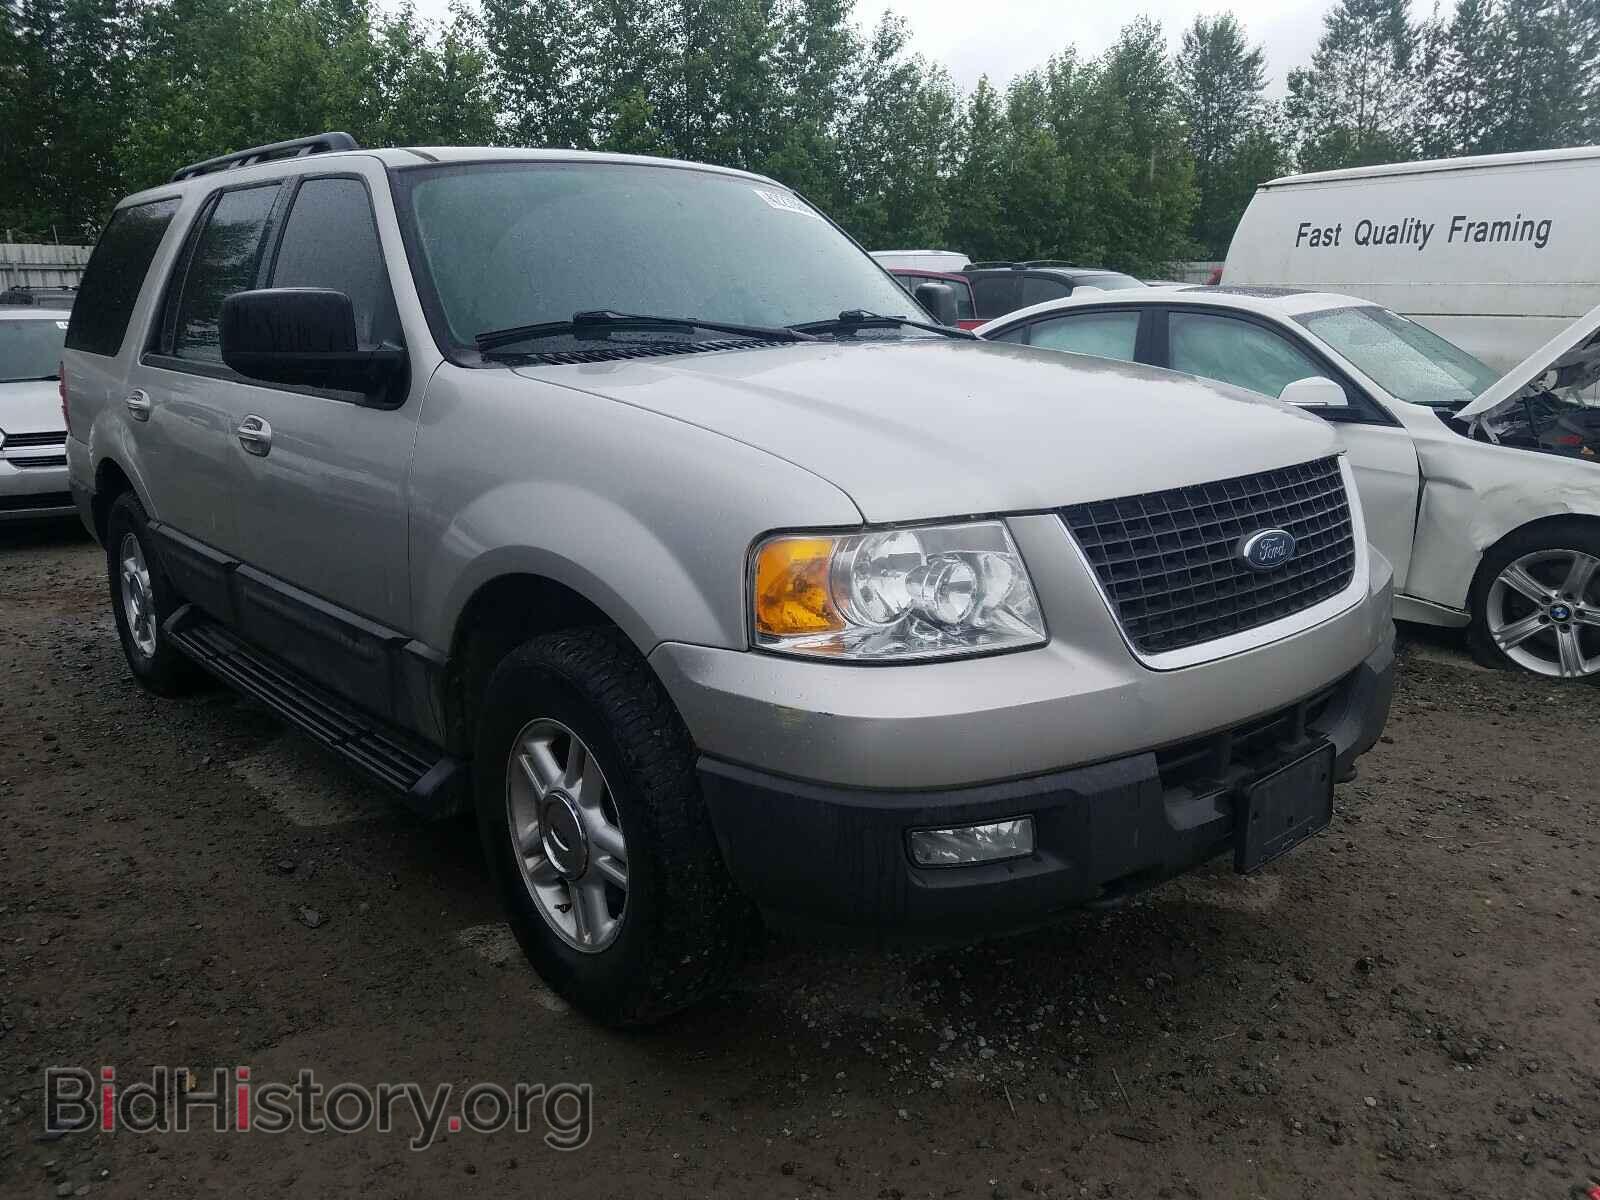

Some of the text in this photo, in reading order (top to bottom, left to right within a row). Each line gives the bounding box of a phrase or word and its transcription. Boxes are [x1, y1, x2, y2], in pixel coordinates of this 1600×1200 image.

[1296, 214, 1552, 251] Fast Quality Framing
[1259, 537, 1286, 561] Ford
